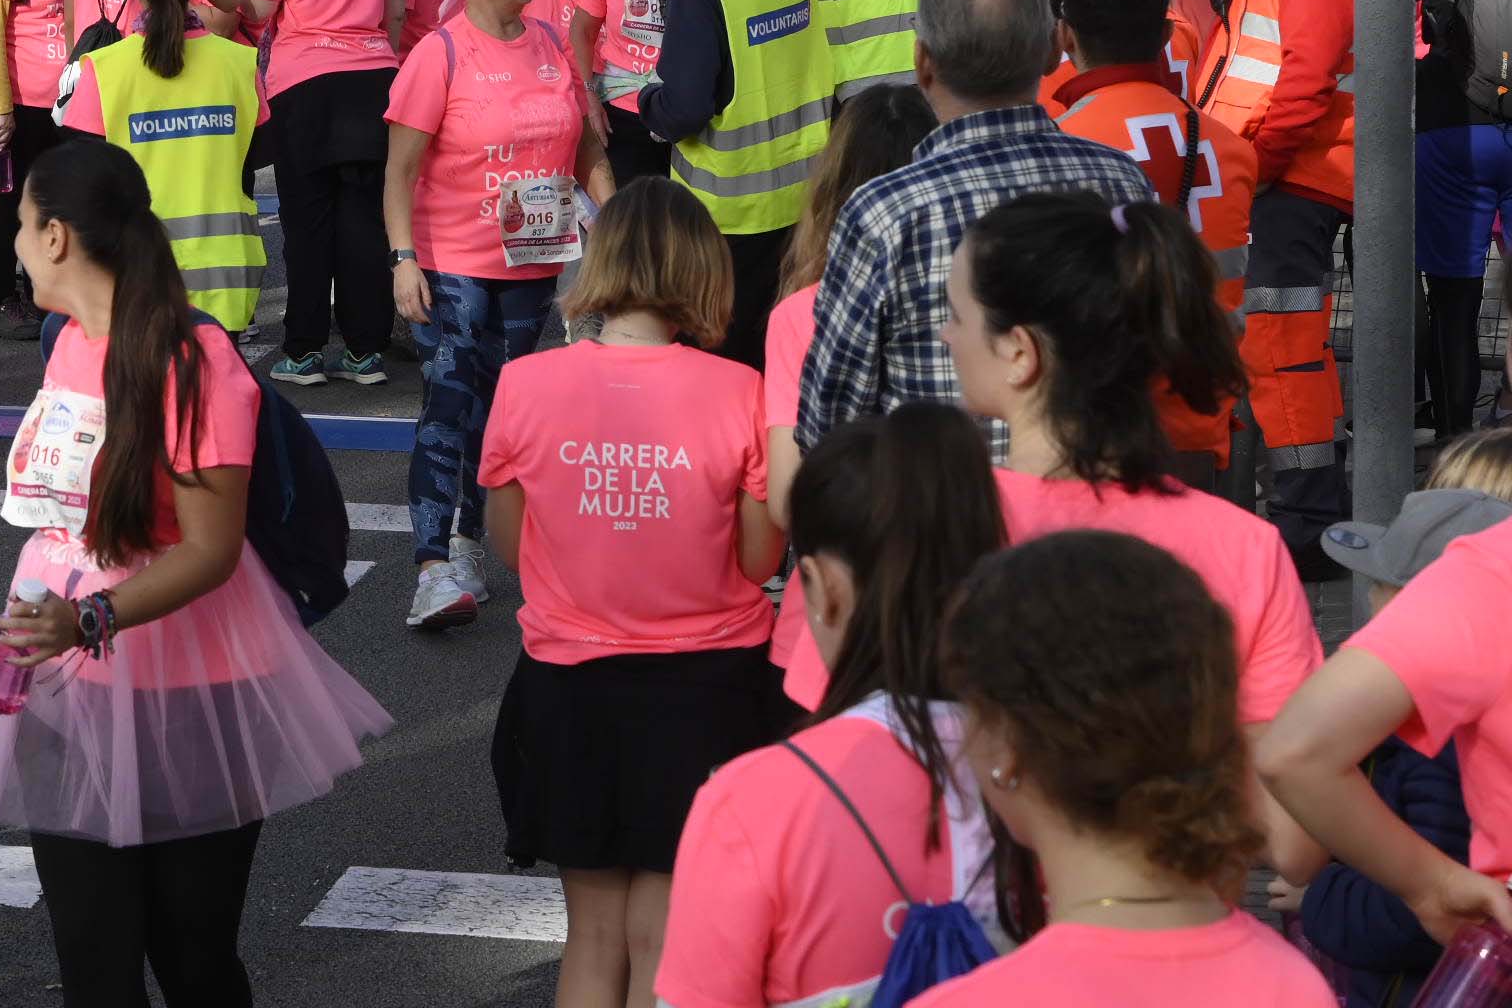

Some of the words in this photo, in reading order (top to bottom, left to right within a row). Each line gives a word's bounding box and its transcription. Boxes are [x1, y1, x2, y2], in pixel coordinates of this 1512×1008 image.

[748, 8, 809, 39] VOLUNTARIS
[131, 112, 234, 136] VOLUNTARIS
[484, 143, 514, 163] TU
[526, 211, 553, 226] 016
[31, 444, 61, 466] 016
[559, 440, 692, 470] CARRERA
[584, 467, 619, 492] DE
[631, 469, 666, 494] LA
[578, 492, 671, 519] MUJER
